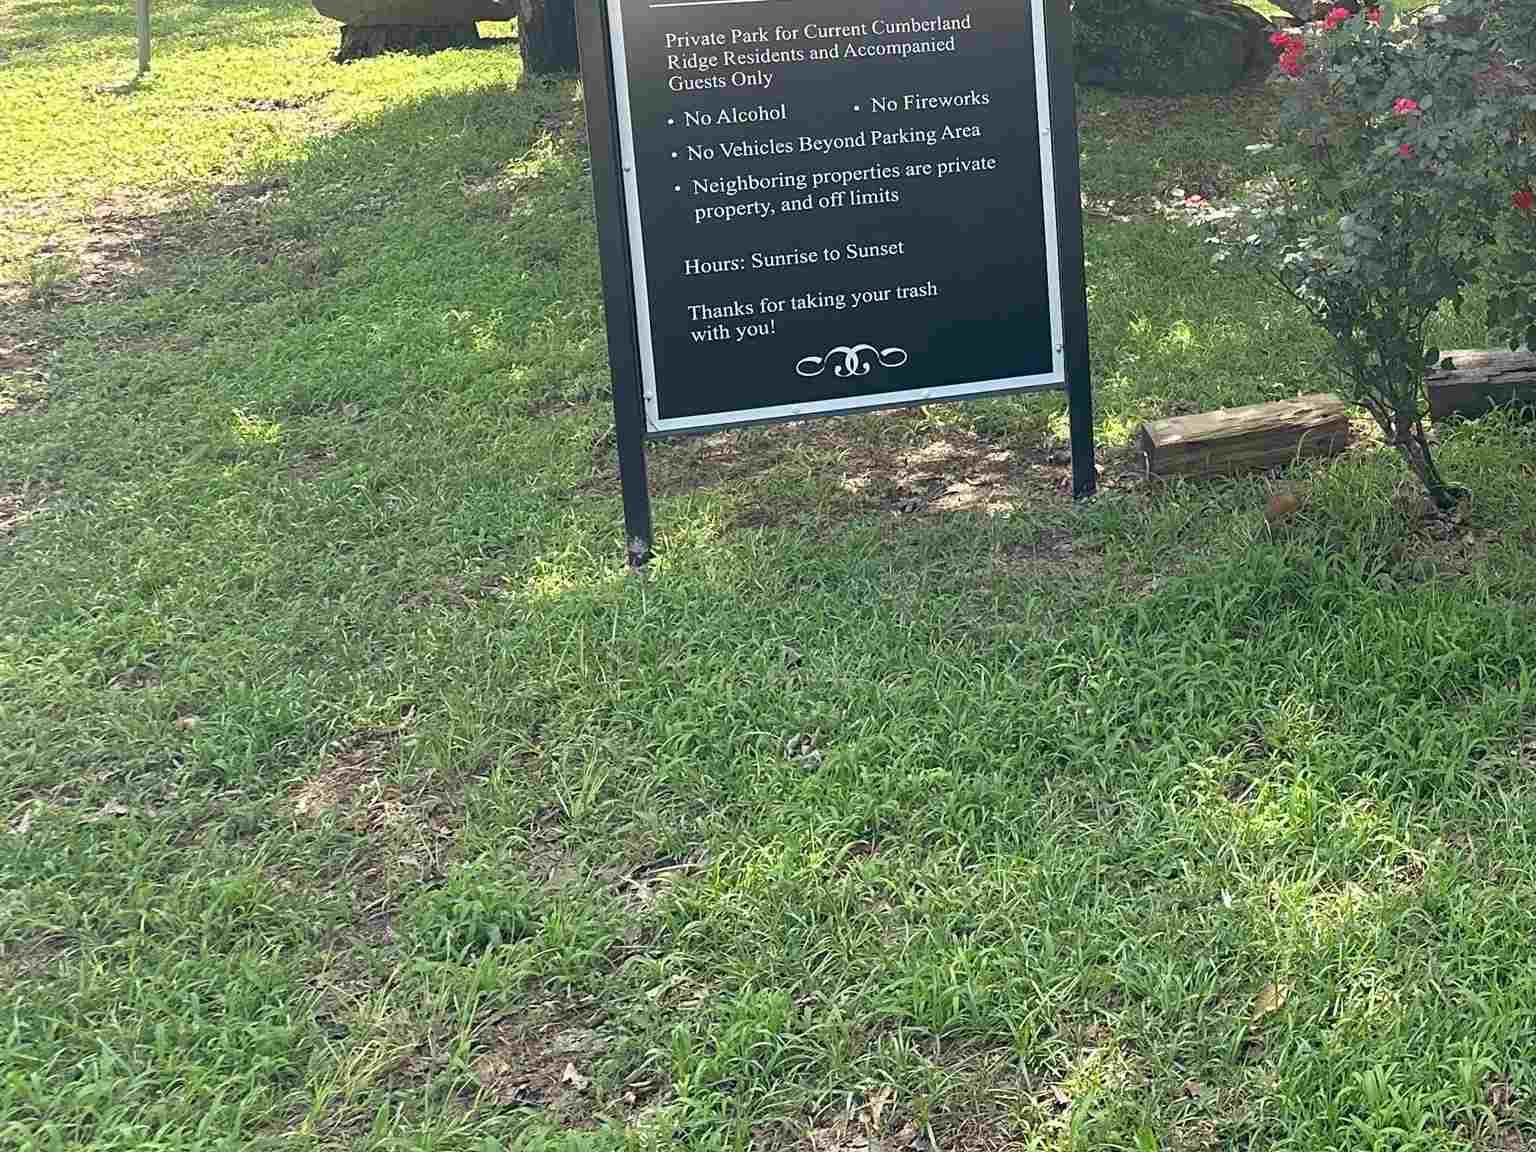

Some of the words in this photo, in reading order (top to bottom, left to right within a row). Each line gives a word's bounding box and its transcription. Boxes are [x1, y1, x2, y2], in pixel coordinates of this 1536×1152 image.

[664, 31, 727, 50] Private
[730, 26, 769, 46] Park
[774, 25, 799, 43] for
[803, 23, 868, 42] Current
[871, 14, 972, 37] Cumberland
[666, 51, 719, 72] Ridge
[722, 45, 806, 66] Residents
[808, 42, 840, 61] and
[843, 35, 956, 59] Accompanied
[668, 72, 728, 92] Guests
[730, 69, 774, 89] Only
[683, 110, 713, 128] No
[715, 104, 788, 125] Alcohol
[870, 95, 899, 113] No
[902, 90, 991, 111] Fireworks
[686, 143, 715, 161] No
[718, 138, 794, 159] Vehicles
[798, 132, 866, 155] Beyond
[870, 127, 937, 148] Parking
[940, 124, 982, 141] Area
[692, 171, 808, 198] Neighboring
[811, 163, 901, 189] properties
[904, 160, 933, 177] are
[936, 156, 997, 177] private
[694, 199, 776, 224] property,
[780, 192, 814, 213] and
[817, 190, 846, 209] off
[849, 187, 900, 208] limits
[684, 257, 745, 276] Hours:
[751, 248, 819, 270] Sunrise
[822, 247, 841, 262] to
[845, 240, 905, 260] Sunset
[687, 300, 755, 322] Thanks
[759, 296, 786, 314] for
[789, 291, 847, 313] taking
[850, 287, 892, 308] your
[895, 280, 939, 299] trash
[689, 321, 731, 343] with
[735, 318, 776, 342] you!
